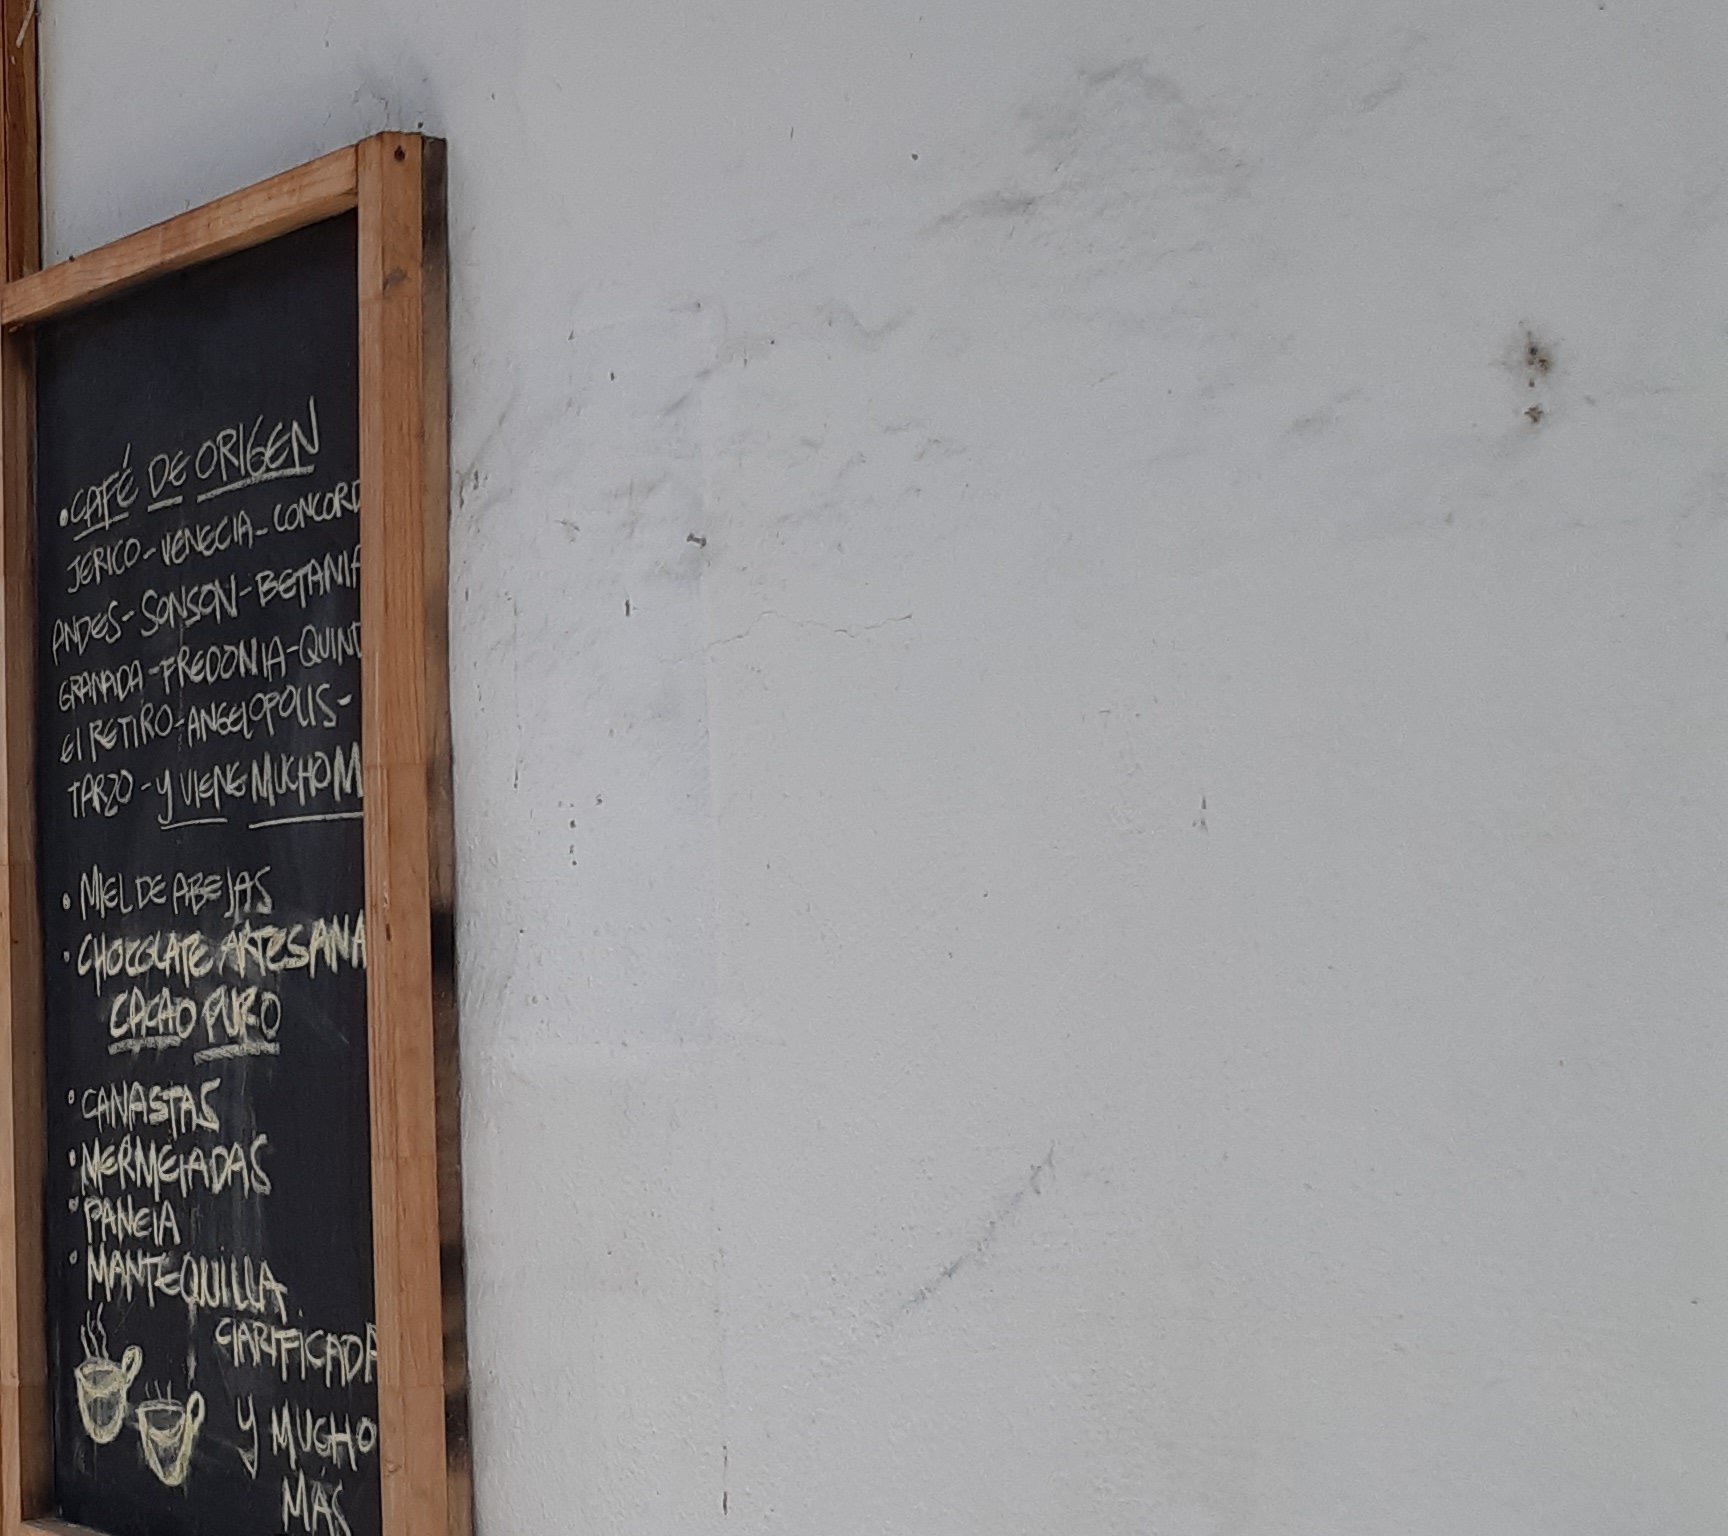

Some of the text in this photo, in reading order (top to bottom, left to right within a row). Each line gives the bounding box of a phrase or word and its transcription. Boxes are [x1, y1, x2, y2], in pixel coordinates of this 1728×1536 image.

[71, 395, 319, 530] CAFÉ DE ORIGEN
[179, 760, 248, 812] VIENE
[81, 863, 273, 924] MIEL DE ABEJAS
[77, 930, 214, 997] CHOCOLATE
[110, 983, 281, 1043] CACAO PURO
[81, 1077, 222, 1141] CANASTAS
[87, 1242, 288, 1323] MANTEQUILLA
[271, 1398, 376, 1472] MUCHO
